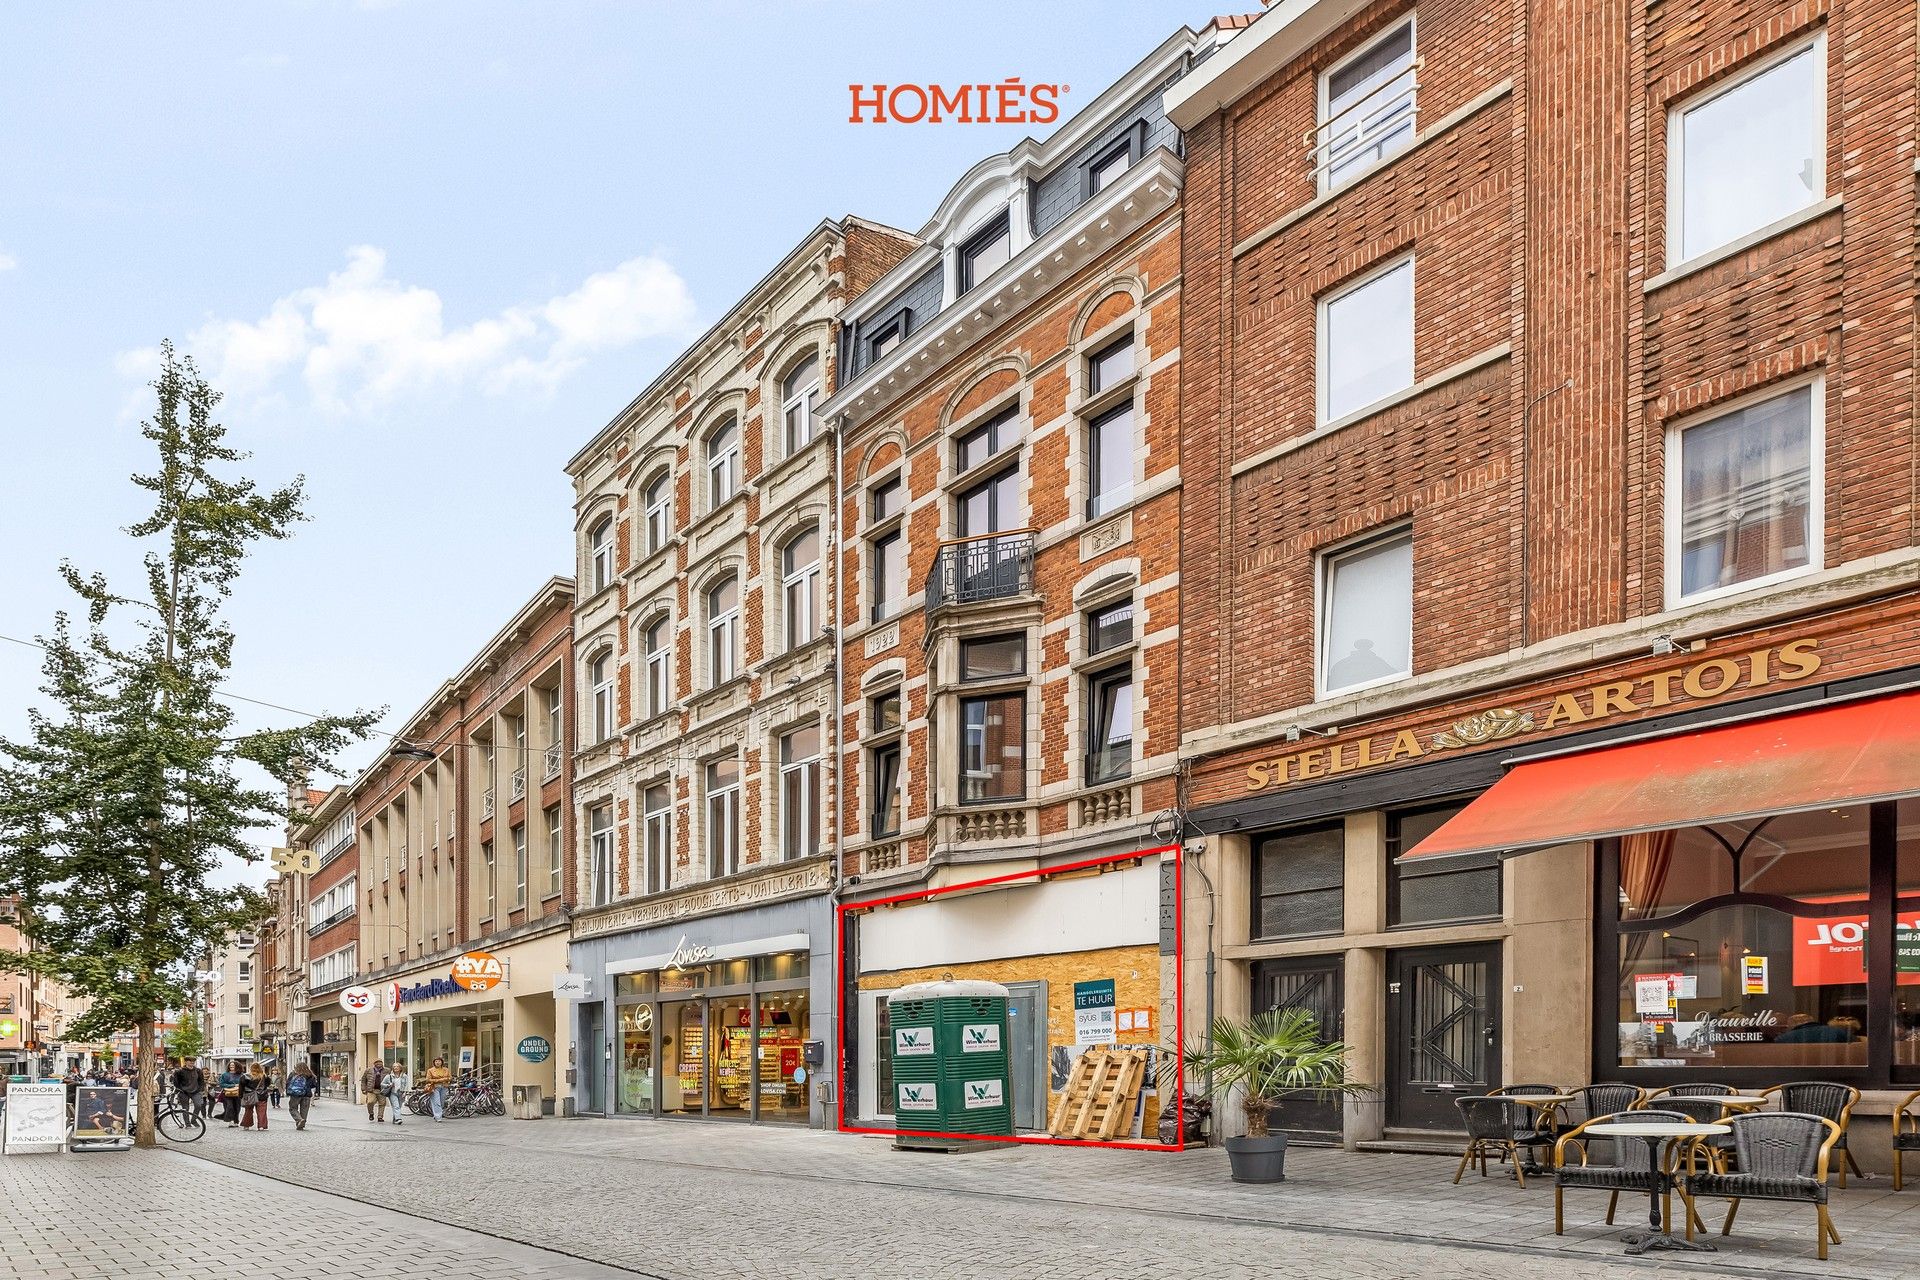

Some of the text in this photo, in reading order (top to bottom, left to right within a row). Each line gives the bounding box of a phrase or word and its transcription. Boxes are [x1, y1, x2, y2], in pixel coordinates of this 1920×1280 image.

[1246, 638, 1822, 791] STELLA ARTOIS
[659, 933, 715, 973] Lovisa
[455, 956, 502, 974] #YA
[1077, 994, 1113, 1006] TE HUUR
[1695, 1010, 1778, 1028] Deauville
[1709, 1032, 1764, 1042] BRASSERIE
